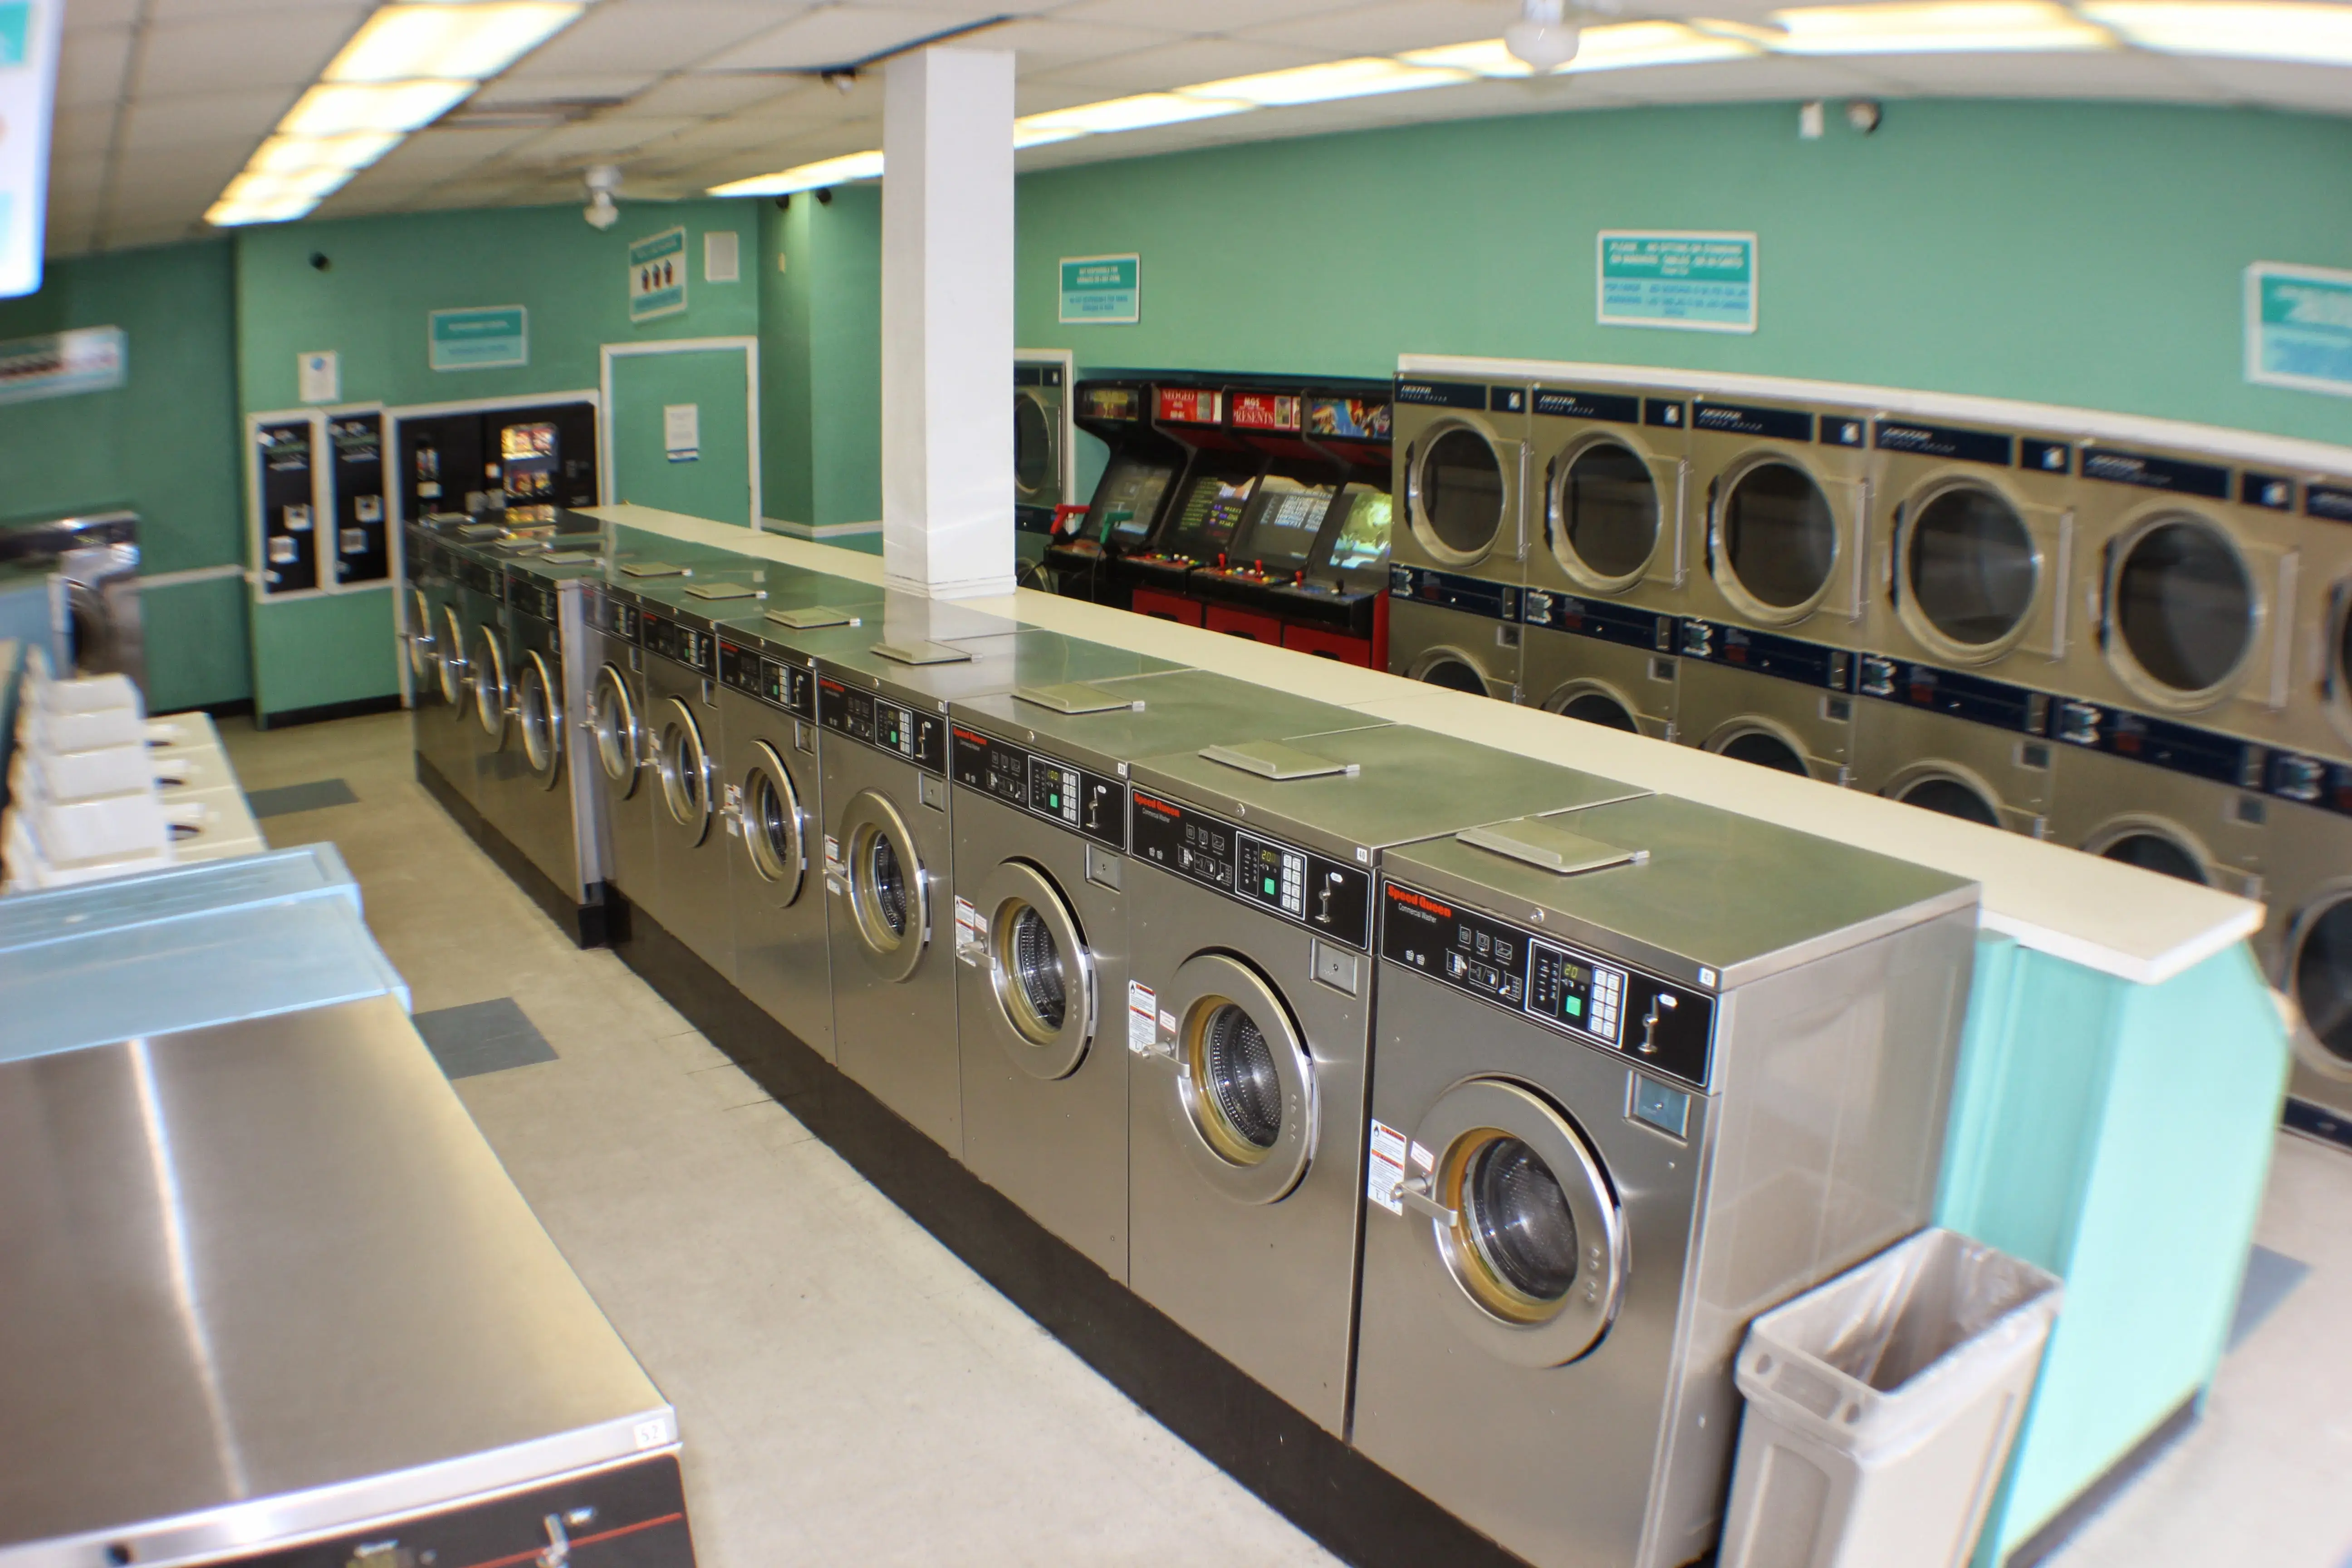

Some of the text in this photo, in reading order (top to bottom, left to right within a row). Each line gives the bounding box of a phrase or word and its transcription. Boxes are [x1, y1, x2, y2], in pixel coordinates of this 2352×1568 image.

[1134, 793, 1180, 817] Speed Queen
[1359, 850, 1365, 860] 40
[1388, 885, 1452, 918] Speed Queen
[1398, 902, 1437, 923] Commercial Washer
